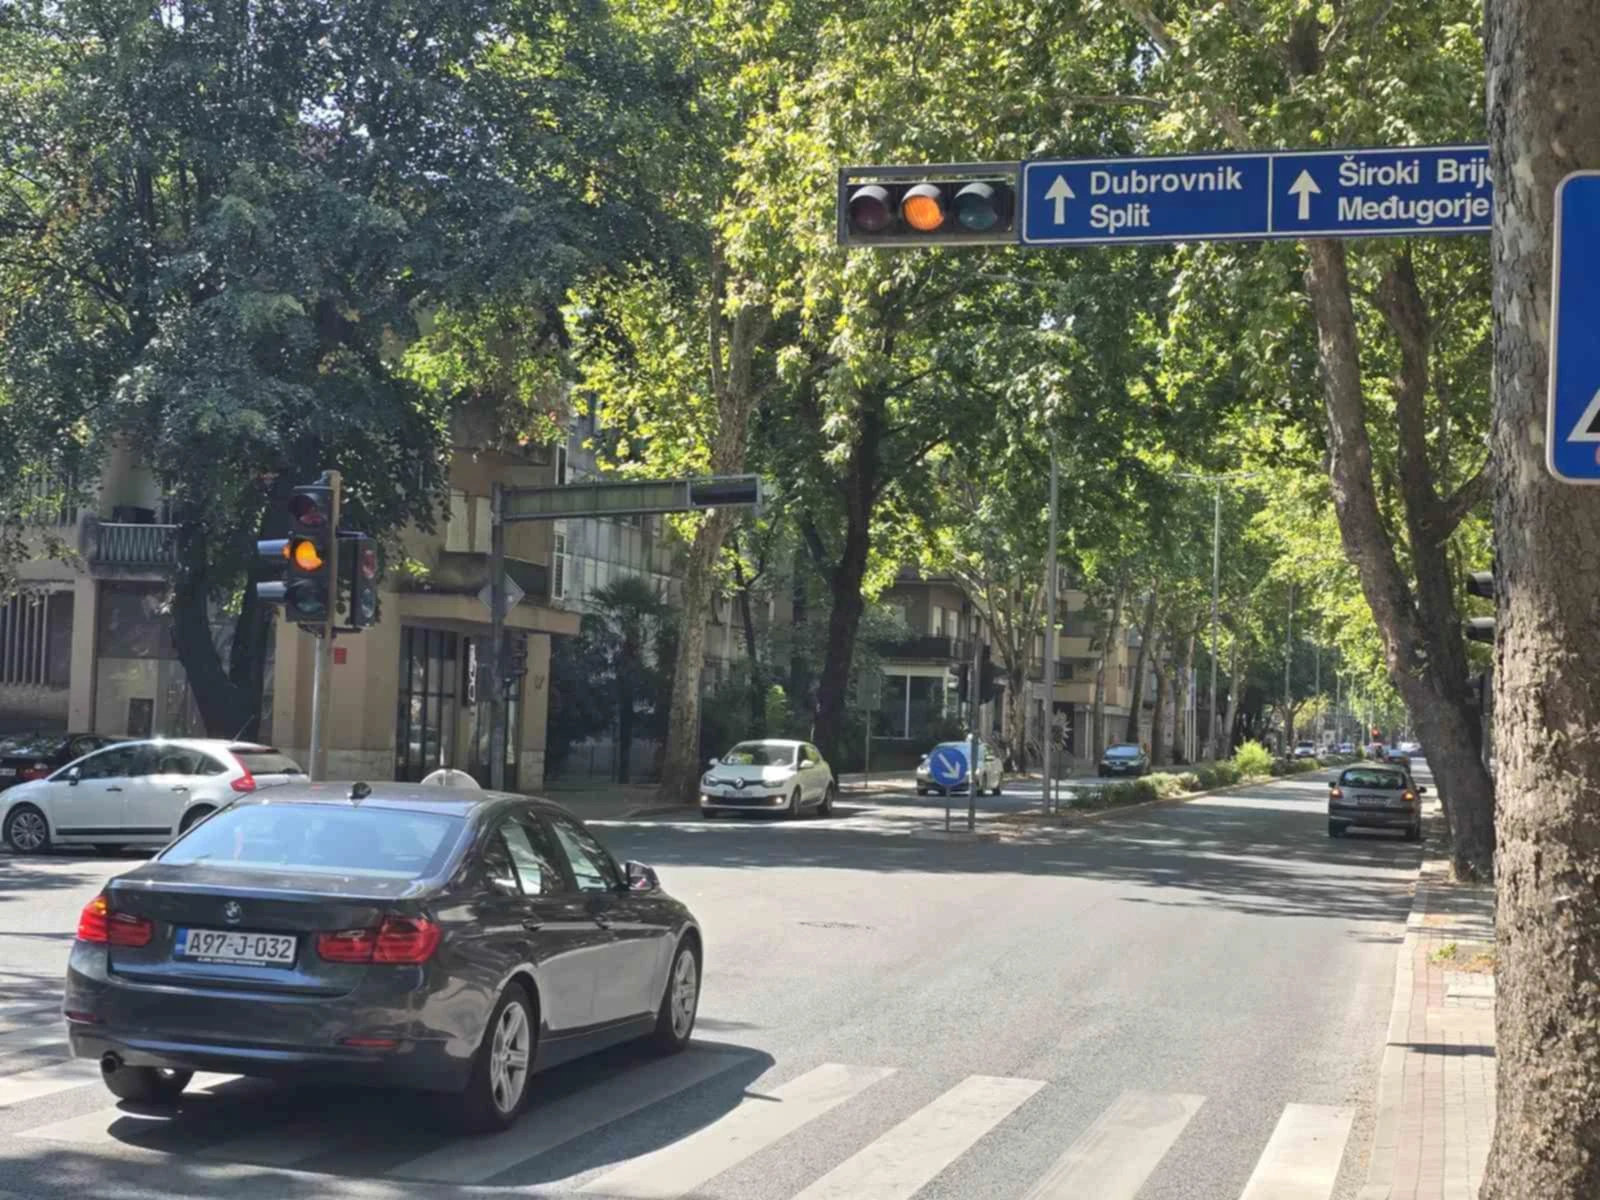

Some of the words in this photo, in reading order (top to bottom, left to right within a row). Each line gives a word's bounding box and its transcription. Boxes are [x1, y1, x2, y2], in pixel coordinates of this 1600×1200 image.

[1090, 167, 1242, 196] Dubrovnik
[1338, 156, 1420, 187] Široki
[1090, 203, 1151, 233] Split
[1338, 192, 1490, 225] Međugorje
[188, 932, 292, 958] A97-J-032
